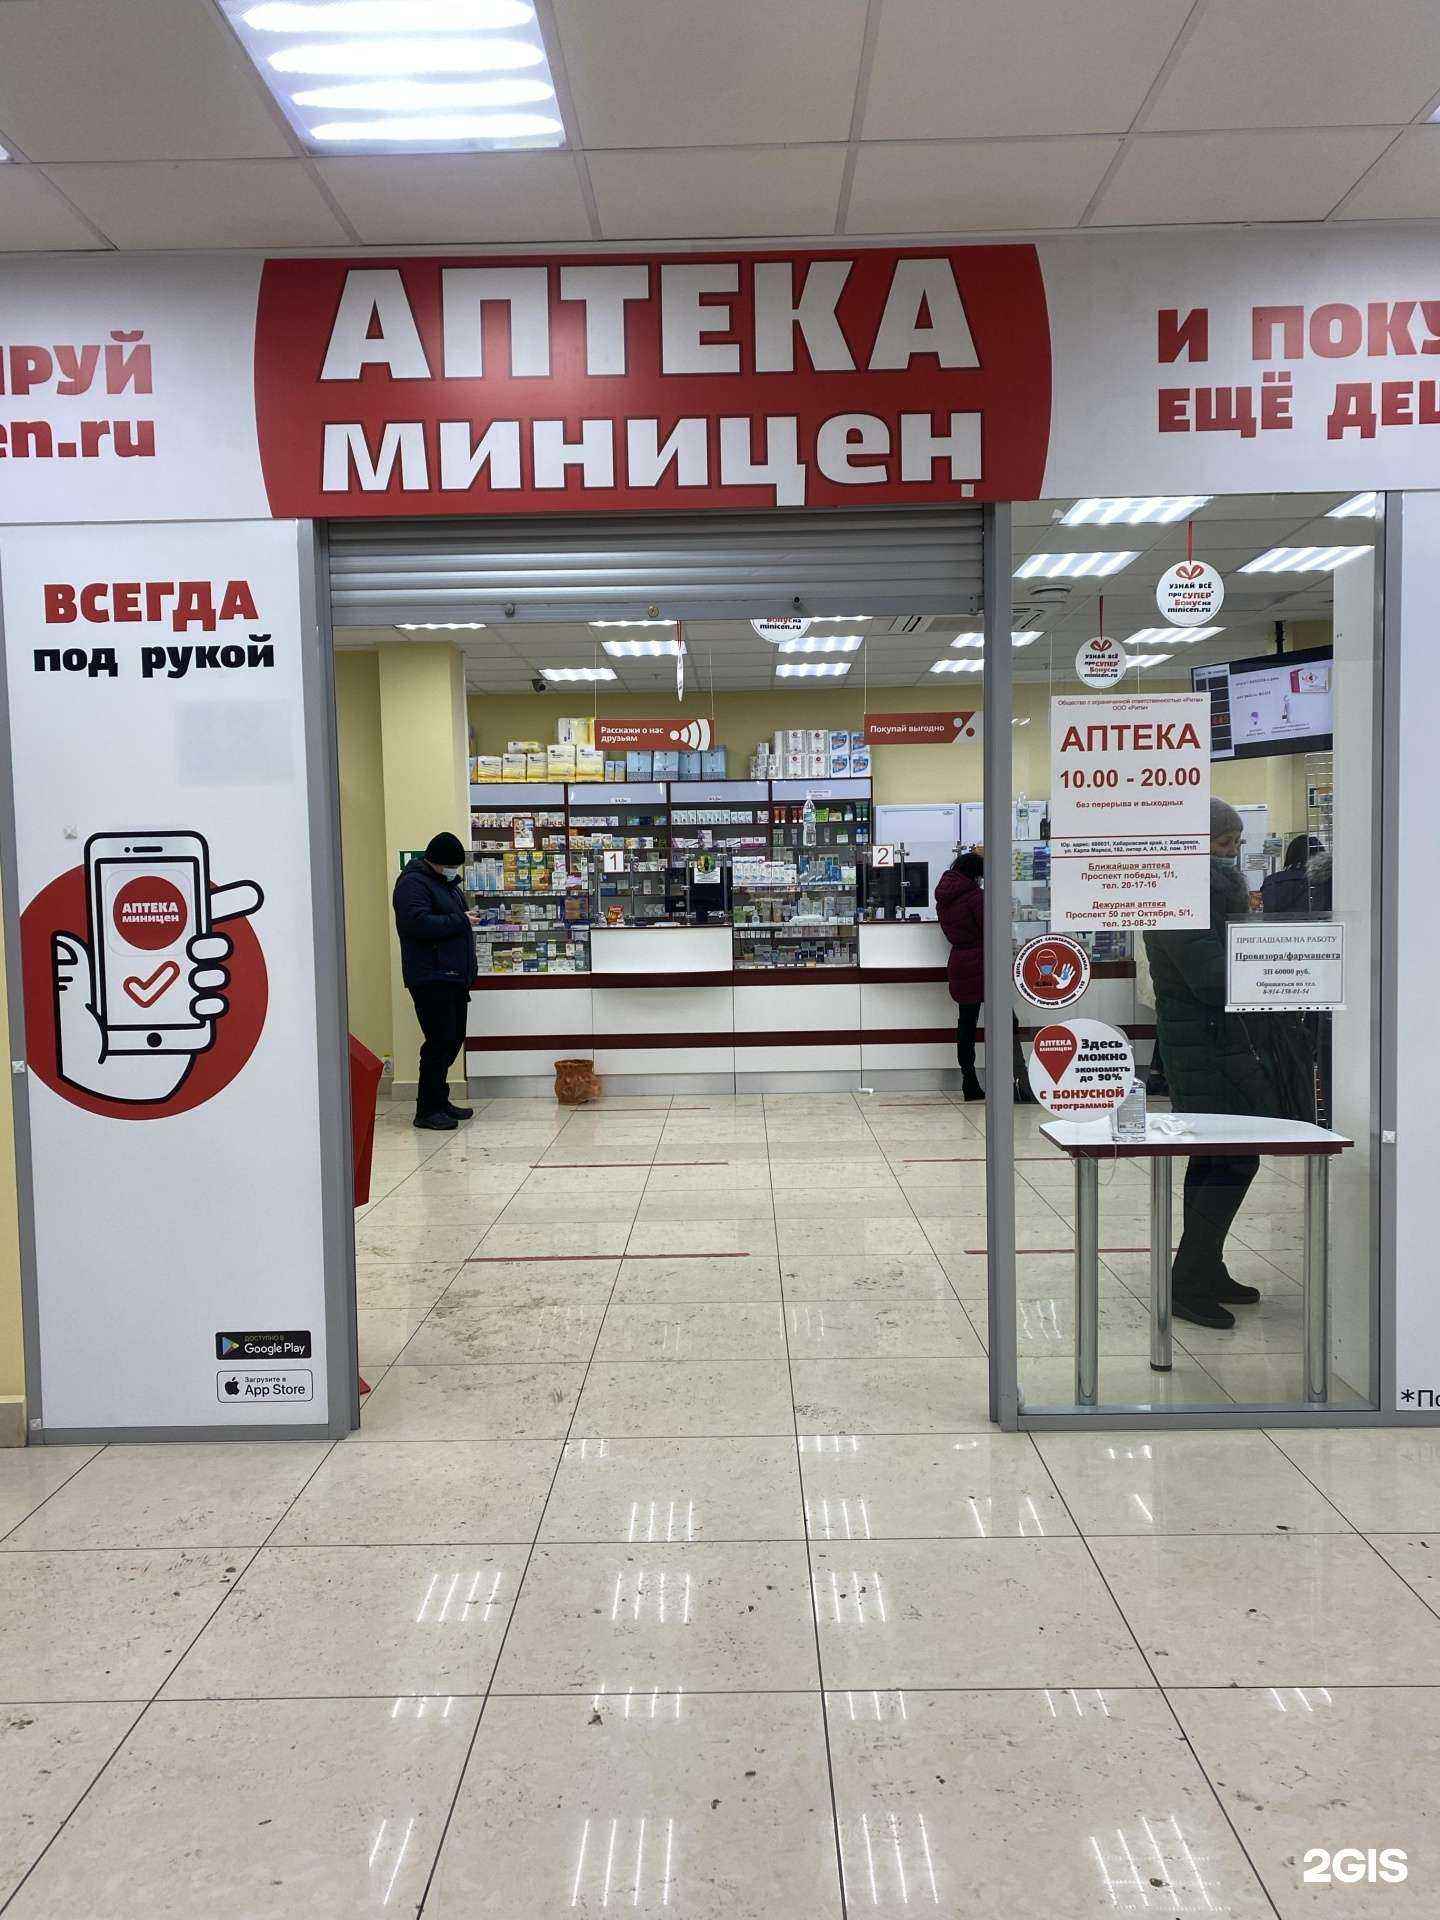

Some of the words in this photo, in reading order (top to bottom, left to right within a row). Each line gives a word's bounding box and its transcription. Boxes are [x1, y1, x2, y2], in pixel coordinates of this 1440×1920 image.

[318, 256, 982, 382] АПТЕКА
[1158, 308, 1209, 363] И
[0, 330, 153, 395] РУЙ
[1158, 371, 1293, 438] ЕЩЁ
[0, 420, 156, 458] n.ru
[321, 410, 984, 507] миницен
[43, 580, 260, 633] ВСЕГДА
[760, 622, 802, 630] minicen.ru
[34, 648, 118, 678] под
[142, 634, 275, 679] рукой
[600, 726, 640, 734] Расскажи
[870, 724, 907, 735] Покупай
[908, 725, 945, 734] выгодно
[600, 735, 638, 744] друзьям
[1060, 723, 1201, 752] АПТЕКА
[1060, 768, 1119, 788] 10.00
[1140, 767, 1201, 787] 20.00
[1076, 800, 1090, 808] без
[1092, 801, 1132, 810] перерыва
[1141, 800, 1184, 808] выходных
[877, 847, 889, 865] 2
[609, 853, 617, 871] 1
[1088, 862, 1139, 870] Ближайшая
[1141, 862, 1171, 870] аптека
[1081, 872, 1122, 881] Проспект
[1124, 871, 1161, 880] победы,
[1102, 882, 1120, 890] тел.
[122, 902, 179, 913] АПТЕКА
[1092, 901, 1136, 910] Дежурная
[1137, 901, 1166, 909] аптека
[121, 915, 180, 924] миницен
[1065, 911, 1106, 919] Проспект
[1108, 910, 1119, 918] 50
[1102, 920, 1120, 928] тел.
[1236, 936, 1292, 944] ПРИГЛАШАЕМ
[1306, 935, 1337, 943] РАБОТУ
[1040, 1039, 1072, 1047] АПТЕКА
[1081, 1039, 1124, 1051] Здесь
[1077, 1053, 1128, 1062] можно
[1098, 1073, 1123, 1081] 90%
[1053, 1086, 1125, 1100] БОНУСНОЙ
[1050, 1101, 1115, 1111] программой
[244, 1342, 282, 1356] Google
[284, 1342, 305, 1355] Play
[244, 1376, 281, 1384] Загрузите
[244, 1384, 270, 1397] App
[272, 1384, 306, 1395] Store
